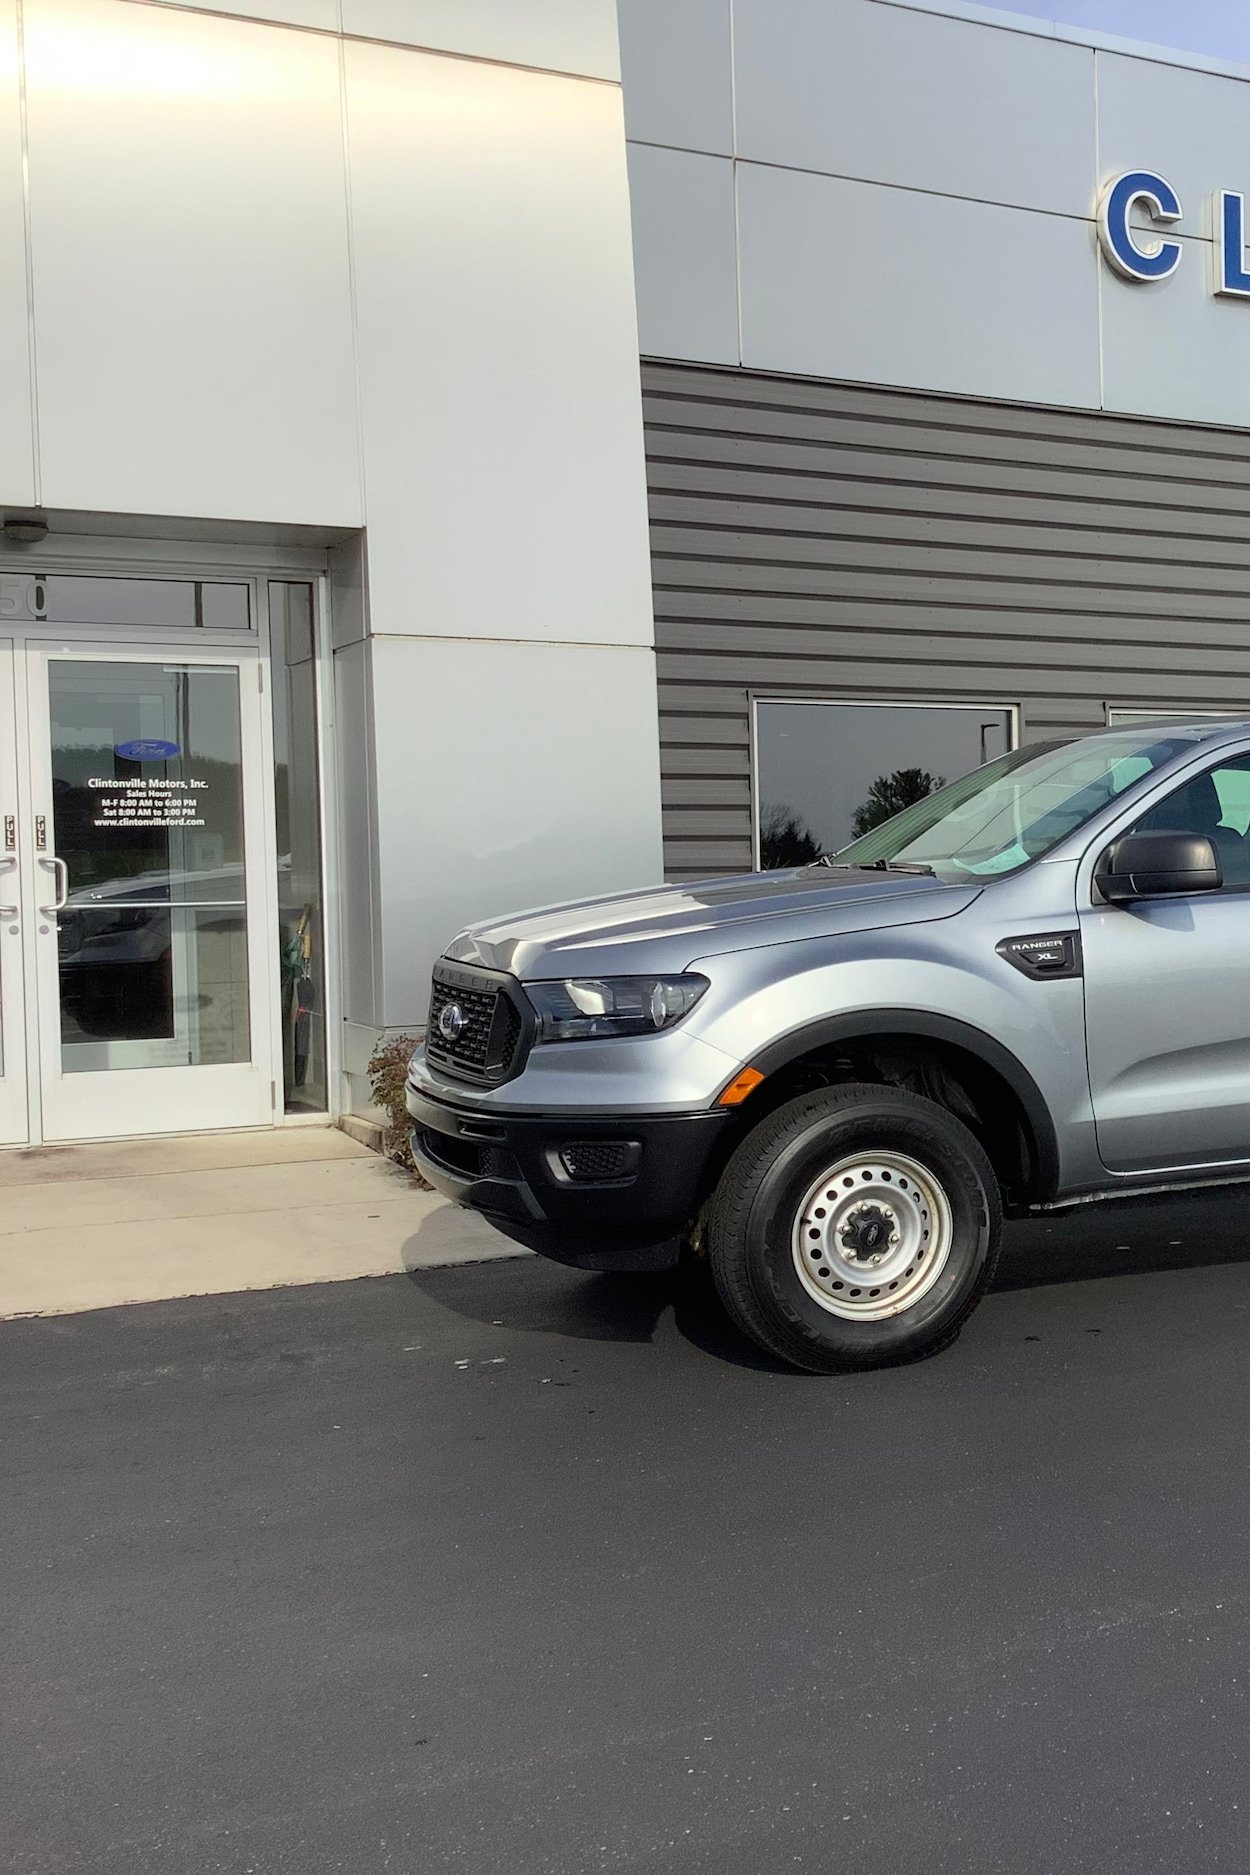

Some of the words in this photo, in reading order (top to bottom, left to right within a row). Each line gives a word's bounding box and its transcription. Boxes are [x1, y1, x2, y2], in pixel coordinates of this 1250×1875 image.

[88, 778, 147, 788] Clintonville
[149, 779, 188, 789] Motors,
[190, 779, 209, 788] Inc.
[126, 790, 147, 798] Sales
[148, 790, 172, 798] Hours
[102, 799, 118, 807] M-F
[119, 799, 137, 807] 8:00
[139, 799, 153, 807] AM
[154, 799, 163, 807] to
[165, 799, 181, 807] 6:00
[183, 799, 197, 807] PM
[103, 808, 117, 816] Sat
[118, 808, 136, 816] 8:00
[137, 808, 151, 816] AM
[153, 808, 162, 816] to
[163, 808, 180, 816] 3:00
[182, 808, 196, 816] PM
[94, 818, 205, 826] www.clintonvilleford.com
[6, 816, 14, 846] PULL
[37, 816, 45, 846] PULL
[1012, 940, 1063, 951] RANGER
[1037, 953, 1058, 961] XL
